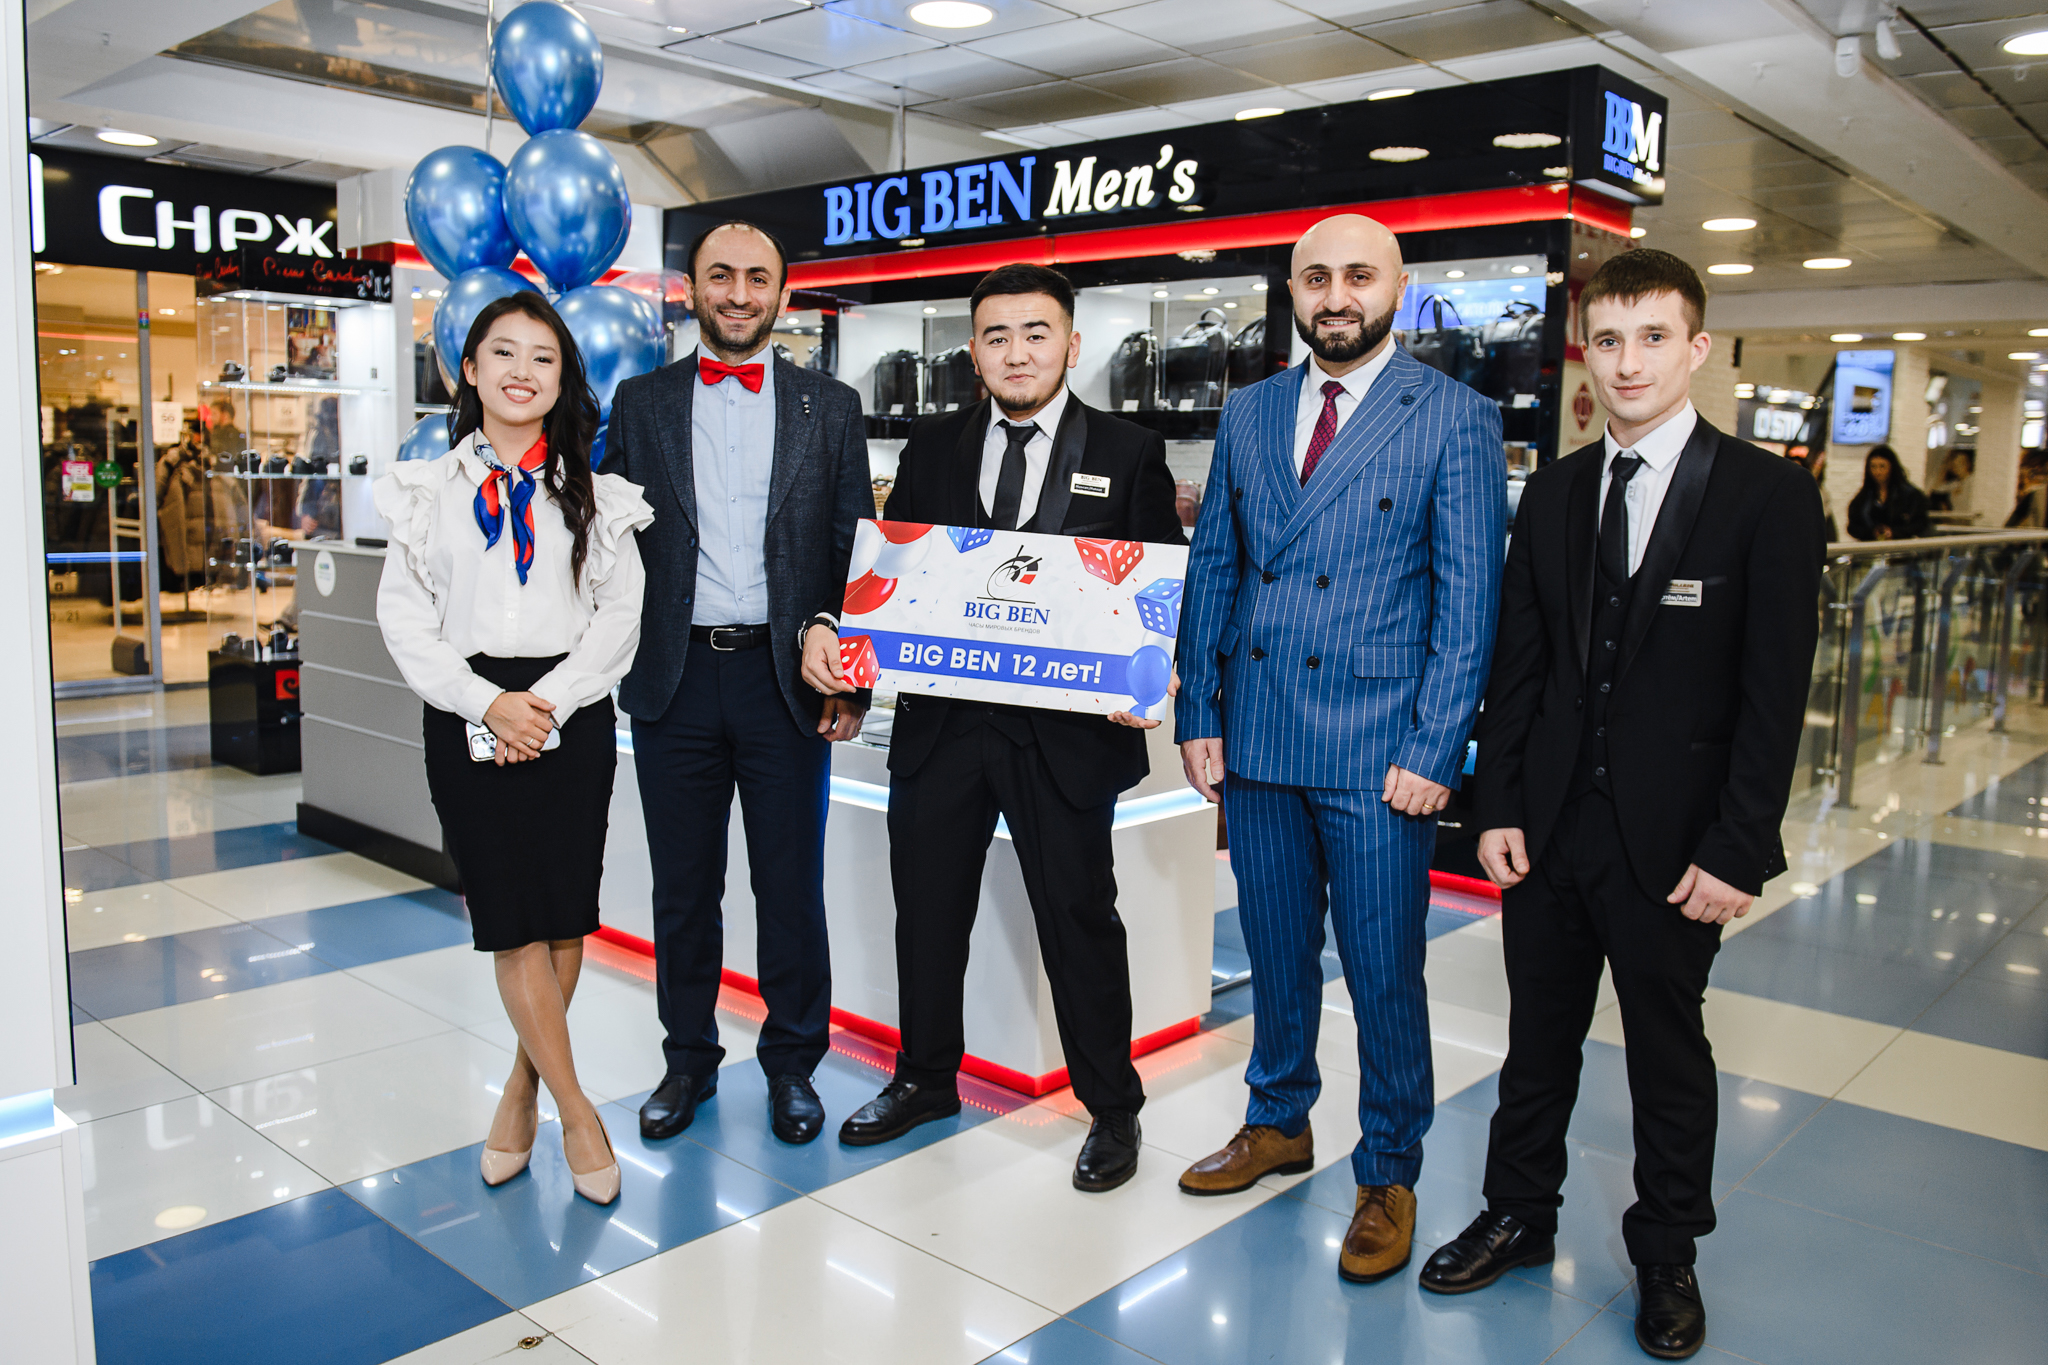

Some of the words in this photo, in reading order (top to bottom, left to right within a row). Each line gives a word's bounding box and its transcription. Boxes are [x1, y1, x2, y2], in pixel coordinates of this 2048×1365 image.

[823, 176, 911, 246] BIG
[920, 156, 1036, 234] BEN
[1043, 144, 1198, 217] Men's
[963, 601, 1000, 620] BIG
[1006, 605, 1051, 625] BEN
[985, 623, 1013, 631] МИРОВЫХ
[1013, 626, 1041, 634] БРЕНДОВ
[899, 642, 943, 667] BIG
[950, 647, 1001, 673] BEN
[1012, 653, 1037, 677] 12
[1042, 660, 1103, 684] лет!
